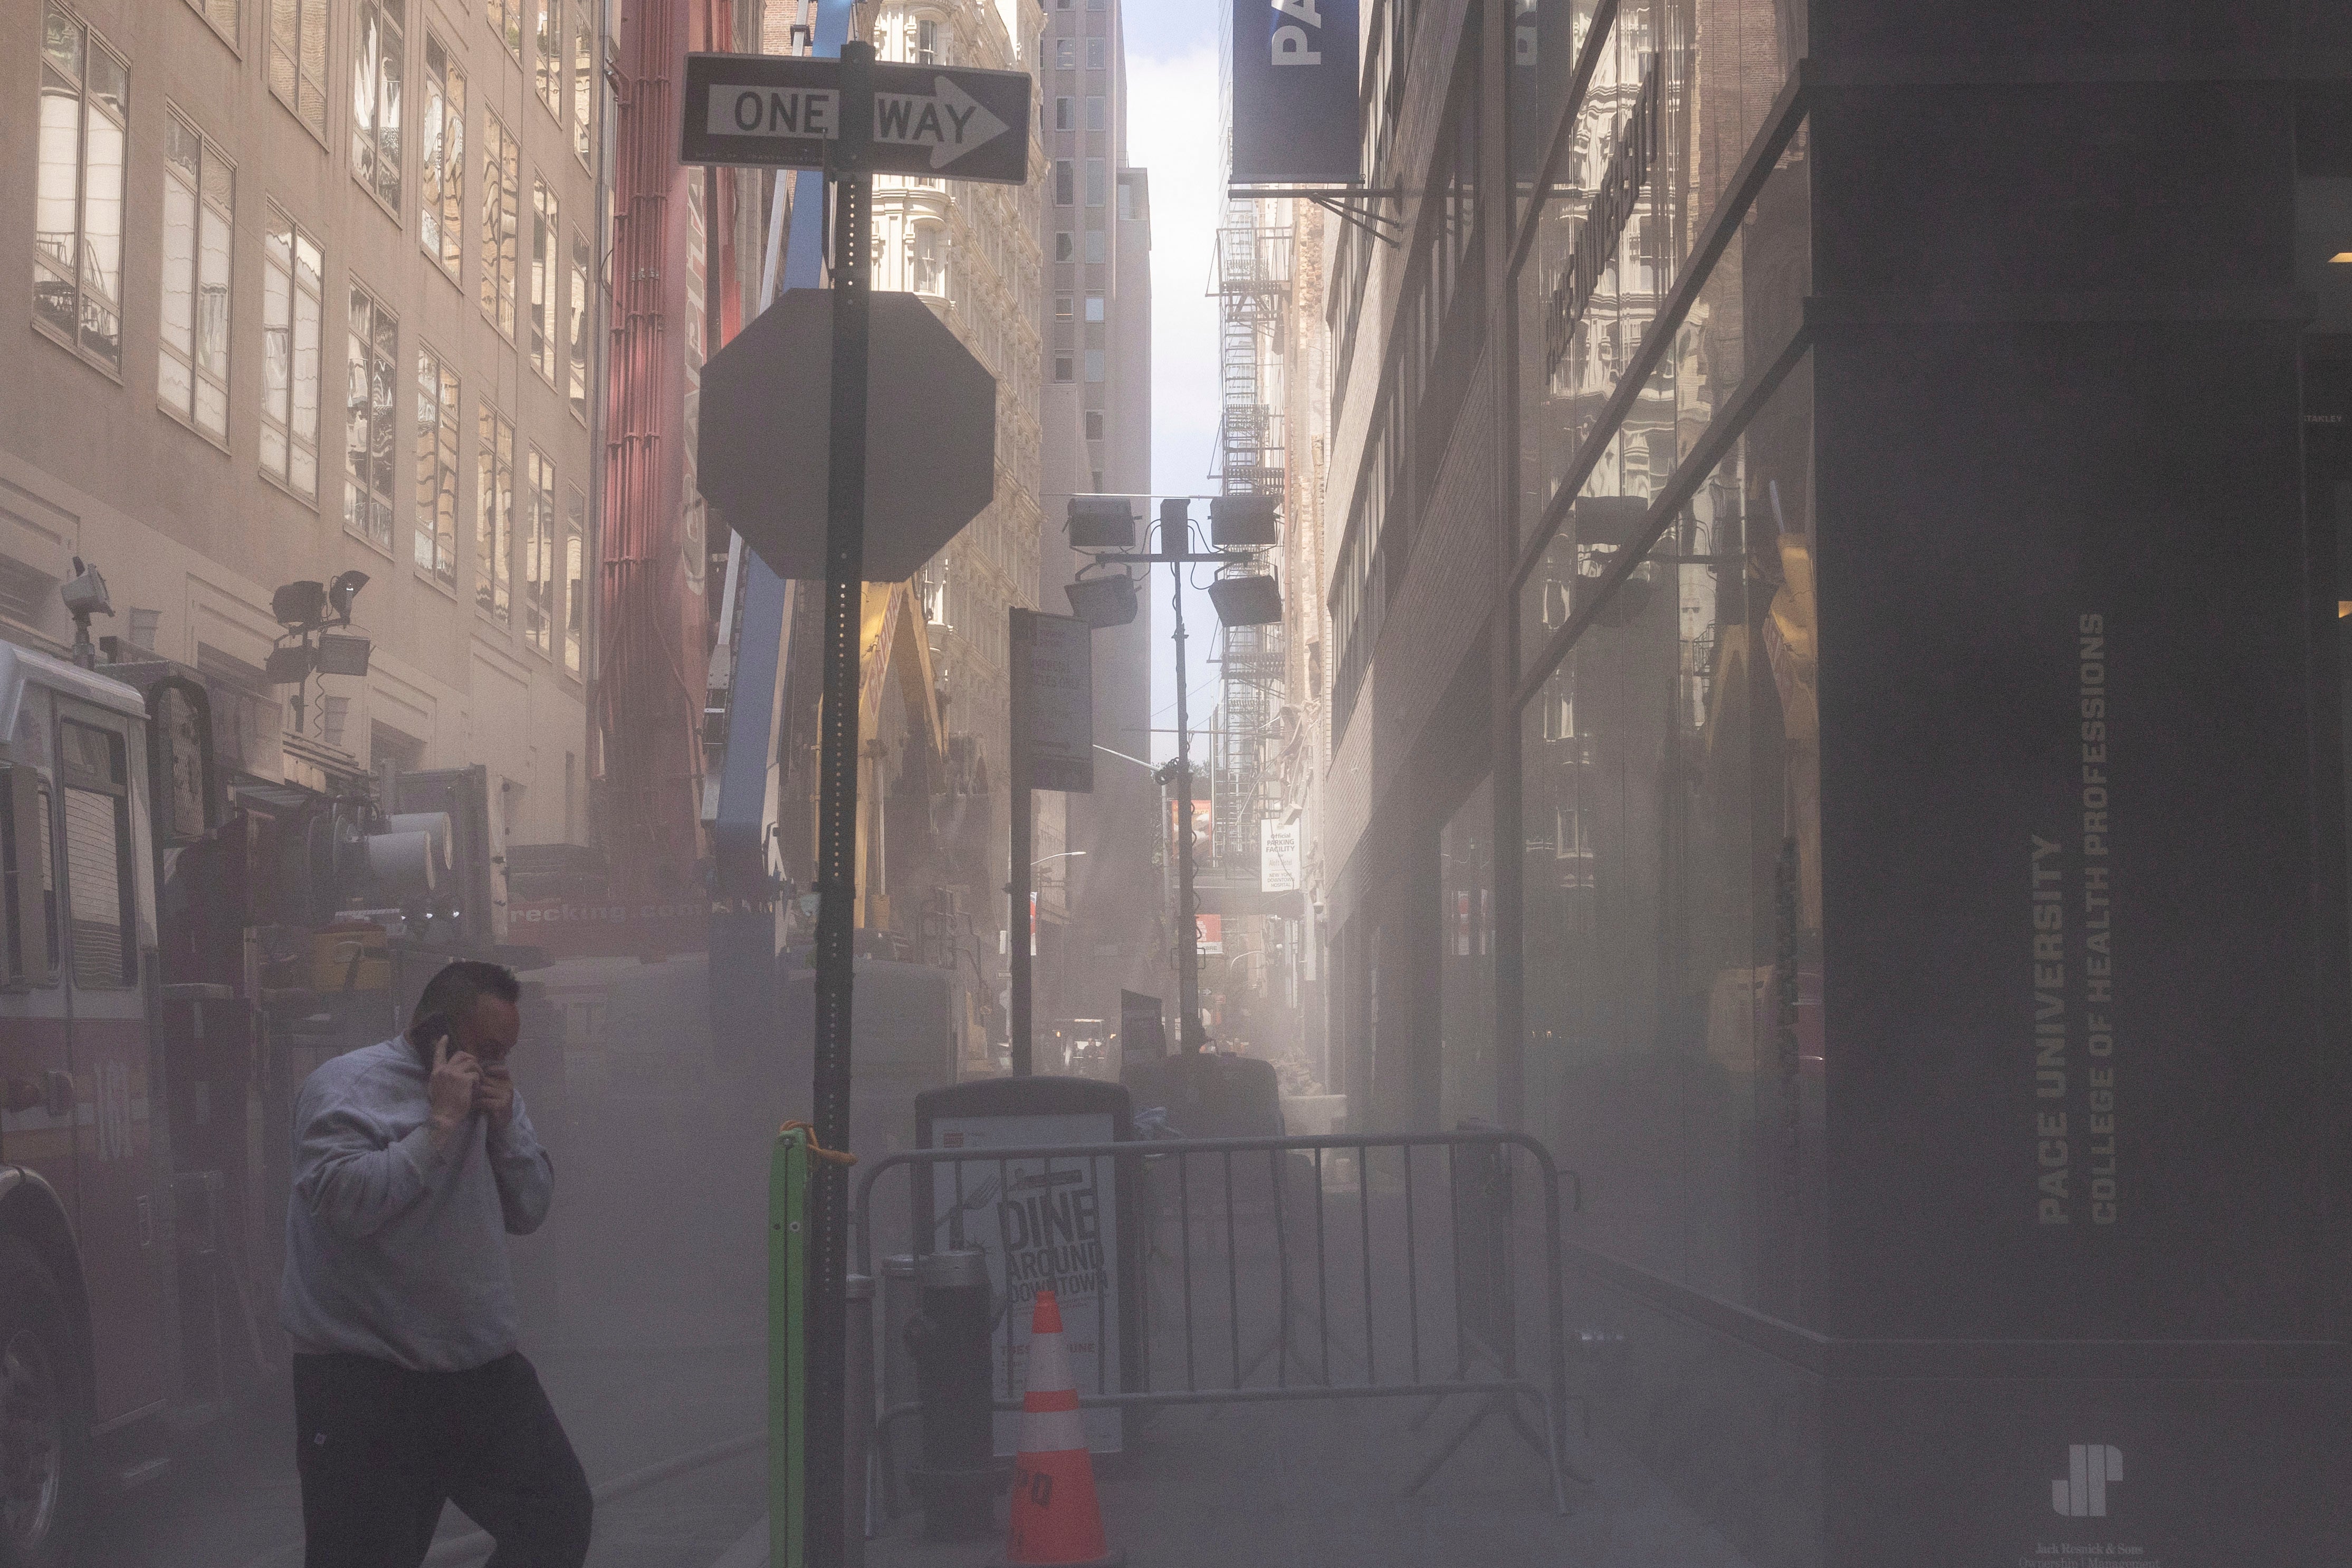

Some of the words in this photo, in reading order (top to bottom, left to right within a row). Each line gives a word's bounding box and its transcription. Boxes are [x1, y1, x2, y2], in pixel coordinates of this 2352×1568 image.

[1271, 0, 1321, 65] PA
[734, 91, 830, 134] ONE
[879, 98, 977, 143] WAY
[2078, 613, 2110, 855] PROFESSIONS
[2031, 834, 2067, 1097] UNIVERSITY
[2085, 867, 2114, 1004] HEALTH
[2089, 1013, 2115, 1055] OF
[2039, 1111, 2069, 1225] PACE
[2090, 1066, 2117, 1225] COLLEGE
[997, 1189, 1098, 1251] DINE
[1008, 1241, 1104, 1283] AROUND
[1066, 1343, 1096, 1353] UNE
[2019, 1557, 2079, 1568] Ownership
[2088, 1557, 2160, 1568] Management
[2035, 1543, 2059, 1555] Jack
[2061, 1543, 2104, 1555] Resnick
[2105, 1543, 2116, 1555] &
[2117, 1543, 2144, 1555] Sons
